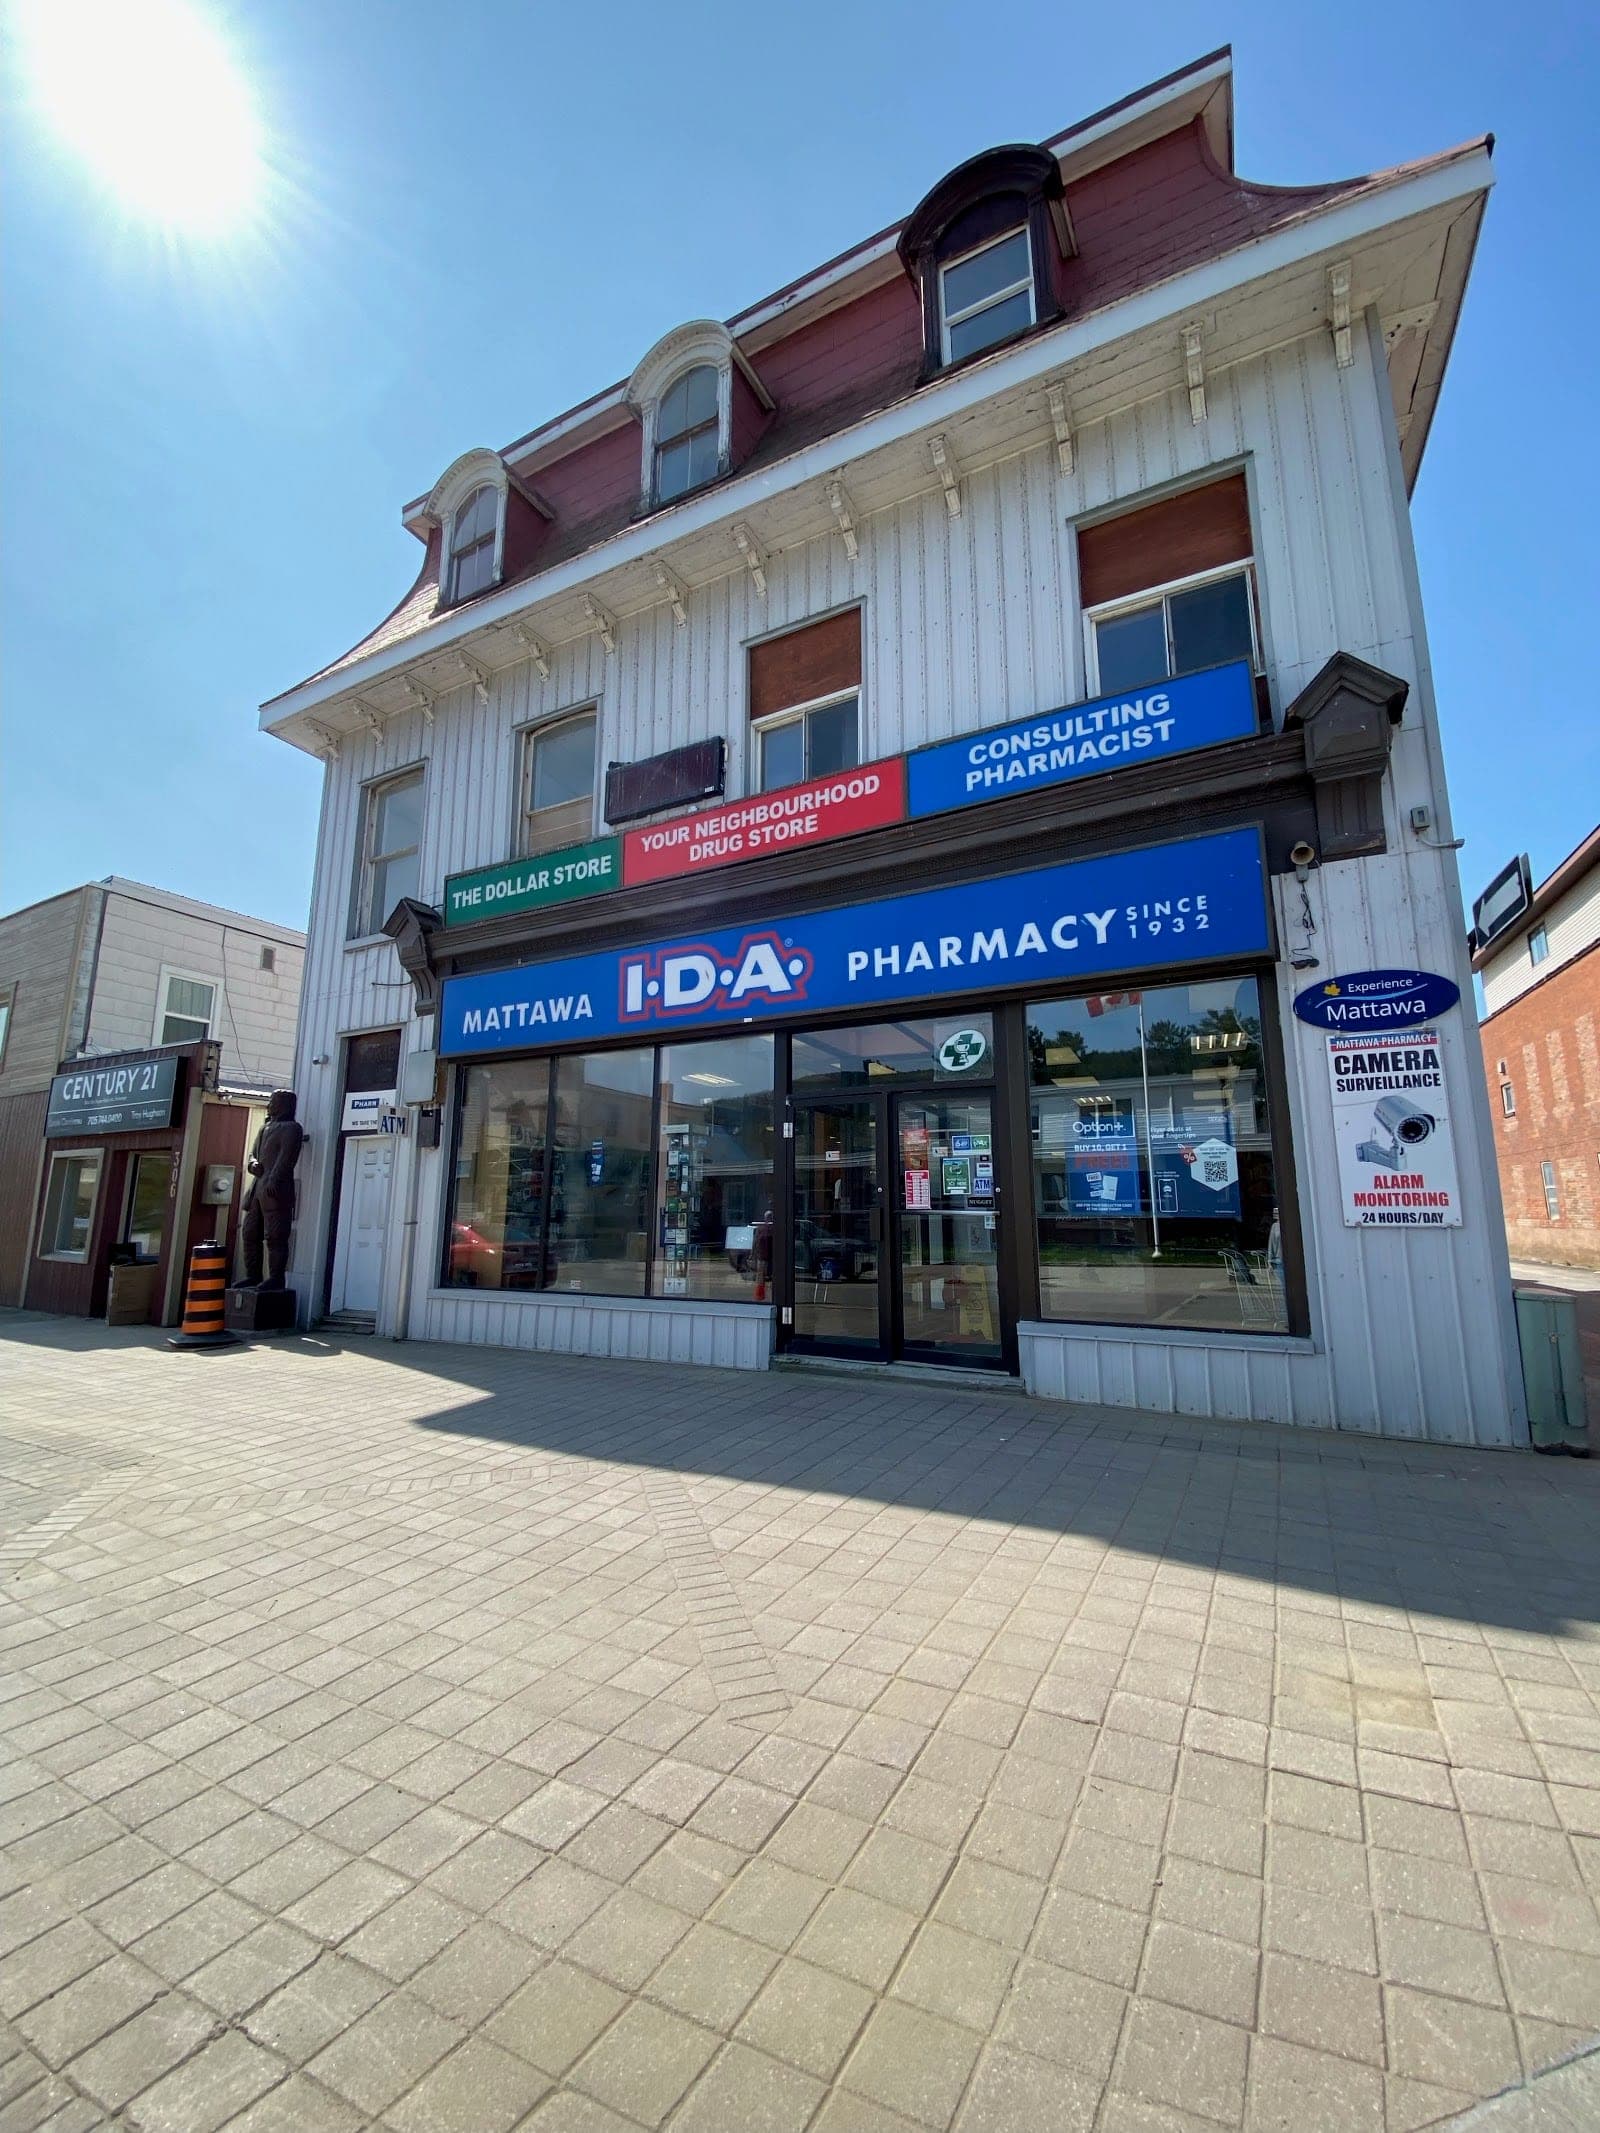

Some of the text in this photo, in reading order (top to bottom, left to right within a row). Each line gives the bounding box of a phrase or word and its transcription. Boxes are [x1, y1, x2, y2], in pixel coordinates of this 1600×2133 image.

[968, 693, 1171, 765] CONSULTING
[965, 718, 1176, 792] PHARMACIST
[640, 775, 880, 852] YOUR NEIGHBOURHOOD
[689, 814, 818, 862] DRUG STORE
[453, 855, 612, 909] THE DOLLAR STORE
[1125, 895, 1208, 921] SINCE
[1128, 914, 1210, 939] 1932
[462, 993, 593, 1034] MATTAWA
[847, 908, 1117, 981] PHARMACY
[1347, 978, 1413, 993] Experience
[1326, 999, 1426, 1021] Mattawa
[1336, 1033, 1432, 1049] MATTAWA PHARMACY
[1334, 1049, 1440, 1076] CAMERA
[63, 1065, 158, 1100] CENTURY 21
[1336, 1073, 1442, 1093] SURVEILLANCE
[380, 1115, 406, 1134] ATM
[974, 1179, 991, 1190] ATM
[1373, 1174, 1424, 1189] ALARM
[1353, 1192, 1450, 1207] MONITORING
[1361, 1212, 1444, 1224] 24 HOURS/DAY
